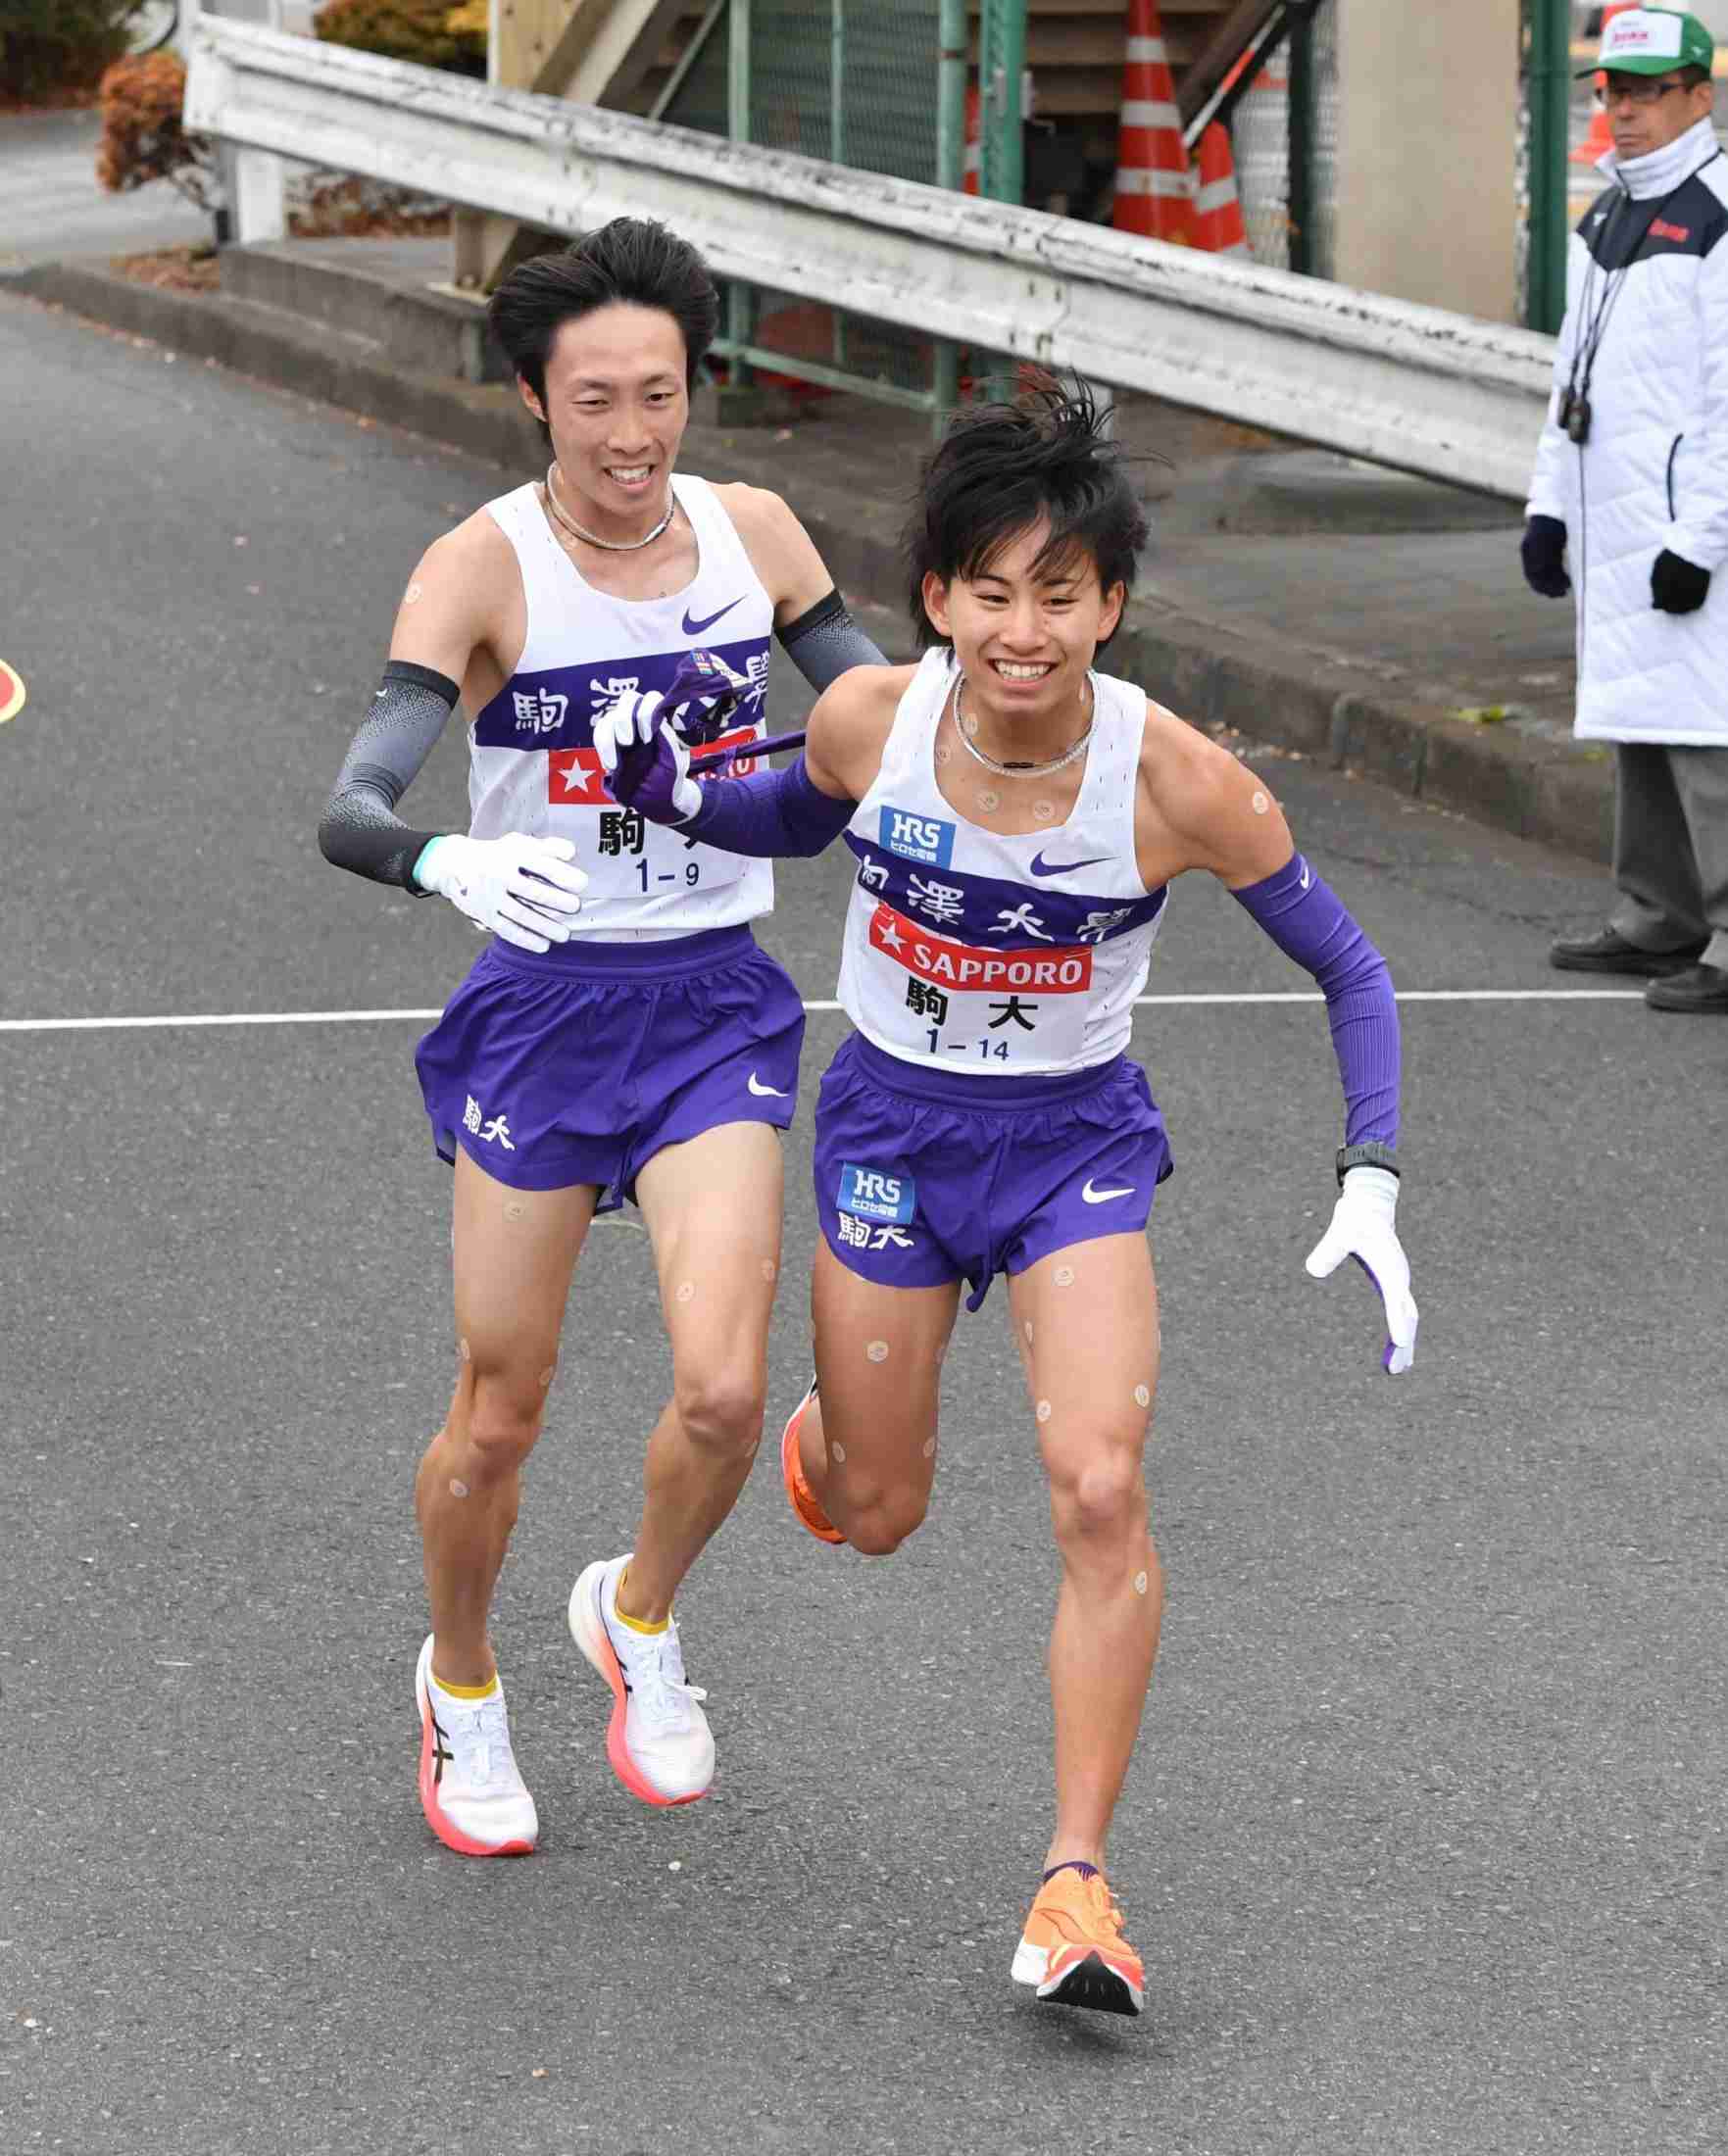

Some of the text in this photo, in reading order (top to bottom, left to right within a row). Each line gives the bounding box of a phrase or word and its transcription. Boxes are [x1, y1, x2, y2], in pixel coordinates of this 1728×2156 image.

[891, 812, 941, 849] HRS
[636, 858, 700, 892] 1-9
[913, 944, 1083, 986] SAPPORO
[905, 976, 1038, 1032] 駒大
[926, 1028, 1010, 1061] 1-14
[855, 1170, 901, 1204] HRS
[837, 1211, 914, 1250] 駒大
